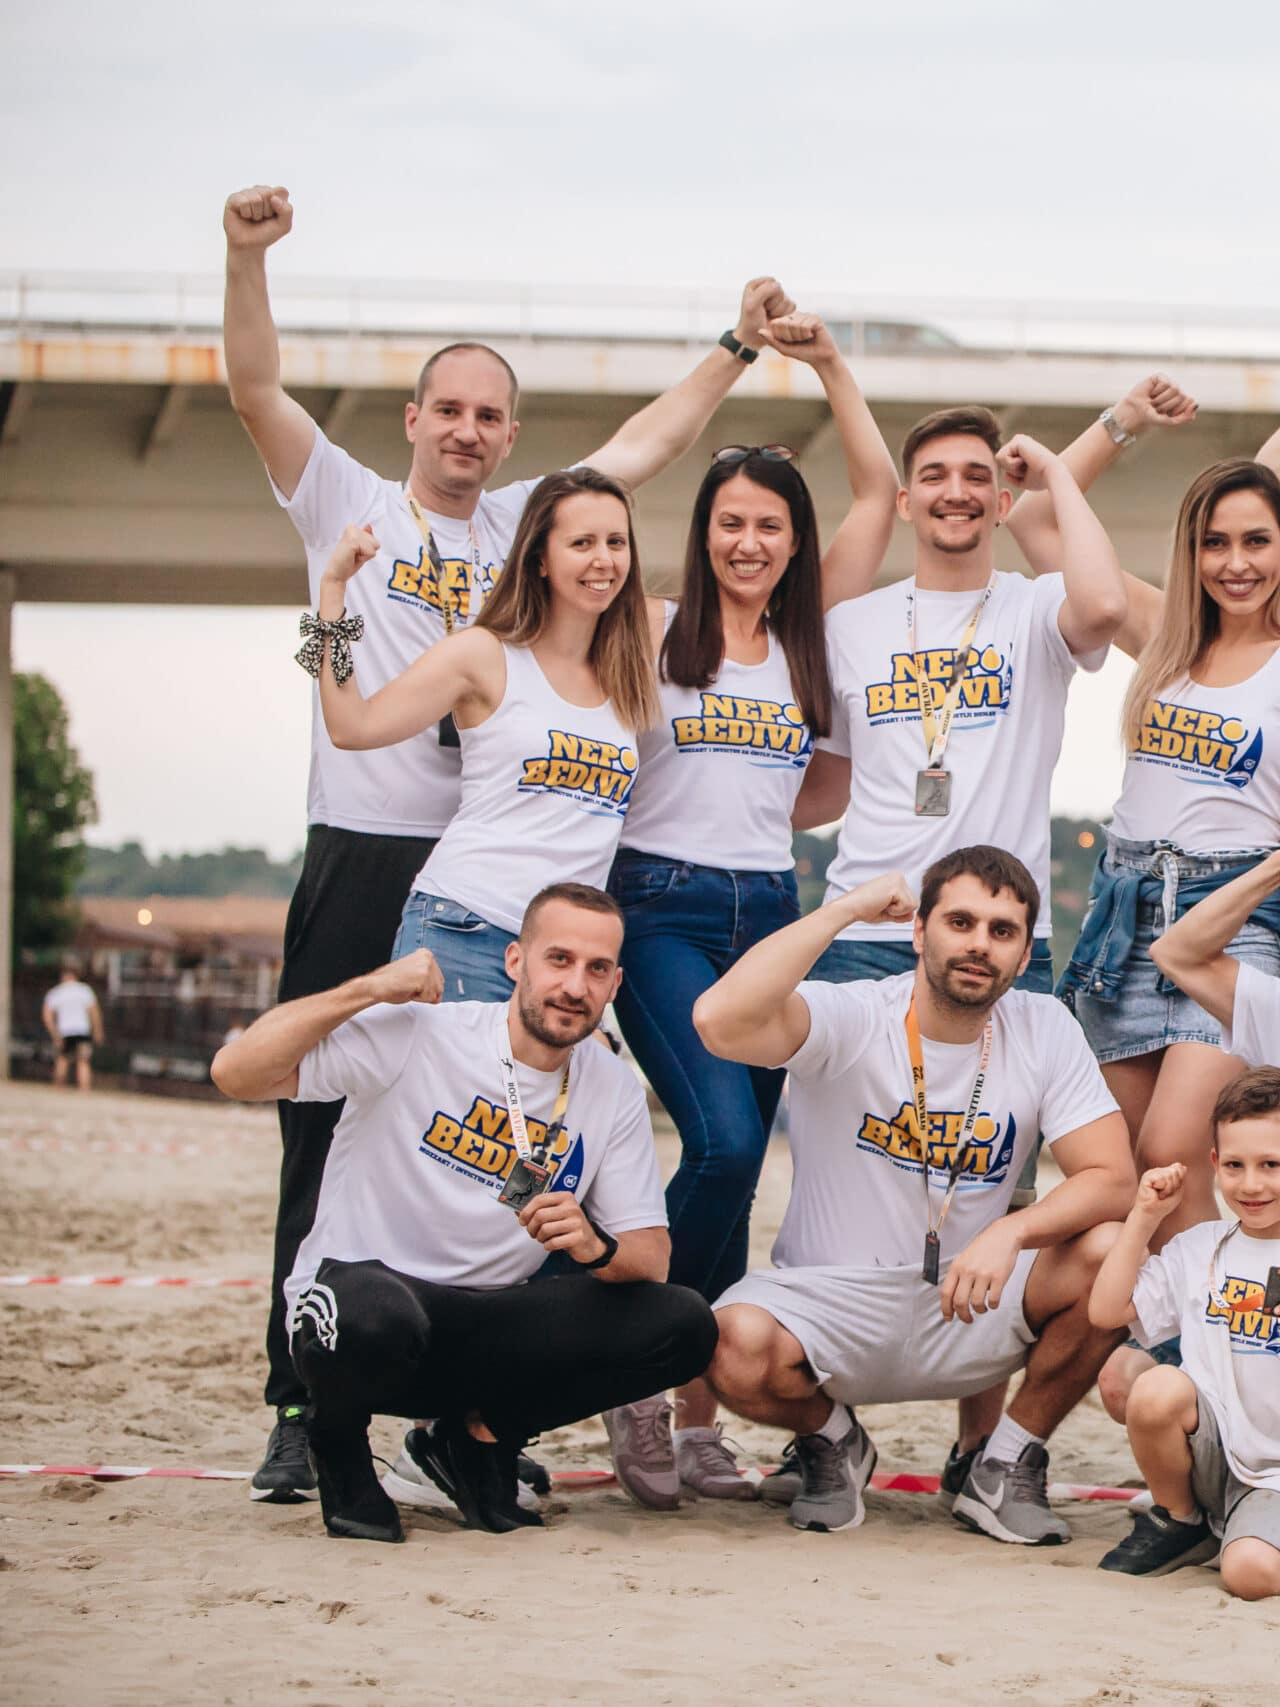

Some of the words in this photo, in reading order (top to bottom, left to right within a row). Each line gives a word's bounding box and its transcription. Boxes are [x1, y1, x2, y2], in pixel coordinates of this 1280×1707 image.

[865, 674, 1003, 717] BEDVI
[672, 716, 805, 755] BEDIVI
[517, 757, 632, 804] BEDIVI
[918, 1091, 927, 1130] STRAND
[964, 1073, 985, 1133] CHALLENGE
[418, 1145, 451, 1168] MOZZART
[455, 1166, 486, 1184] INVICTUS
